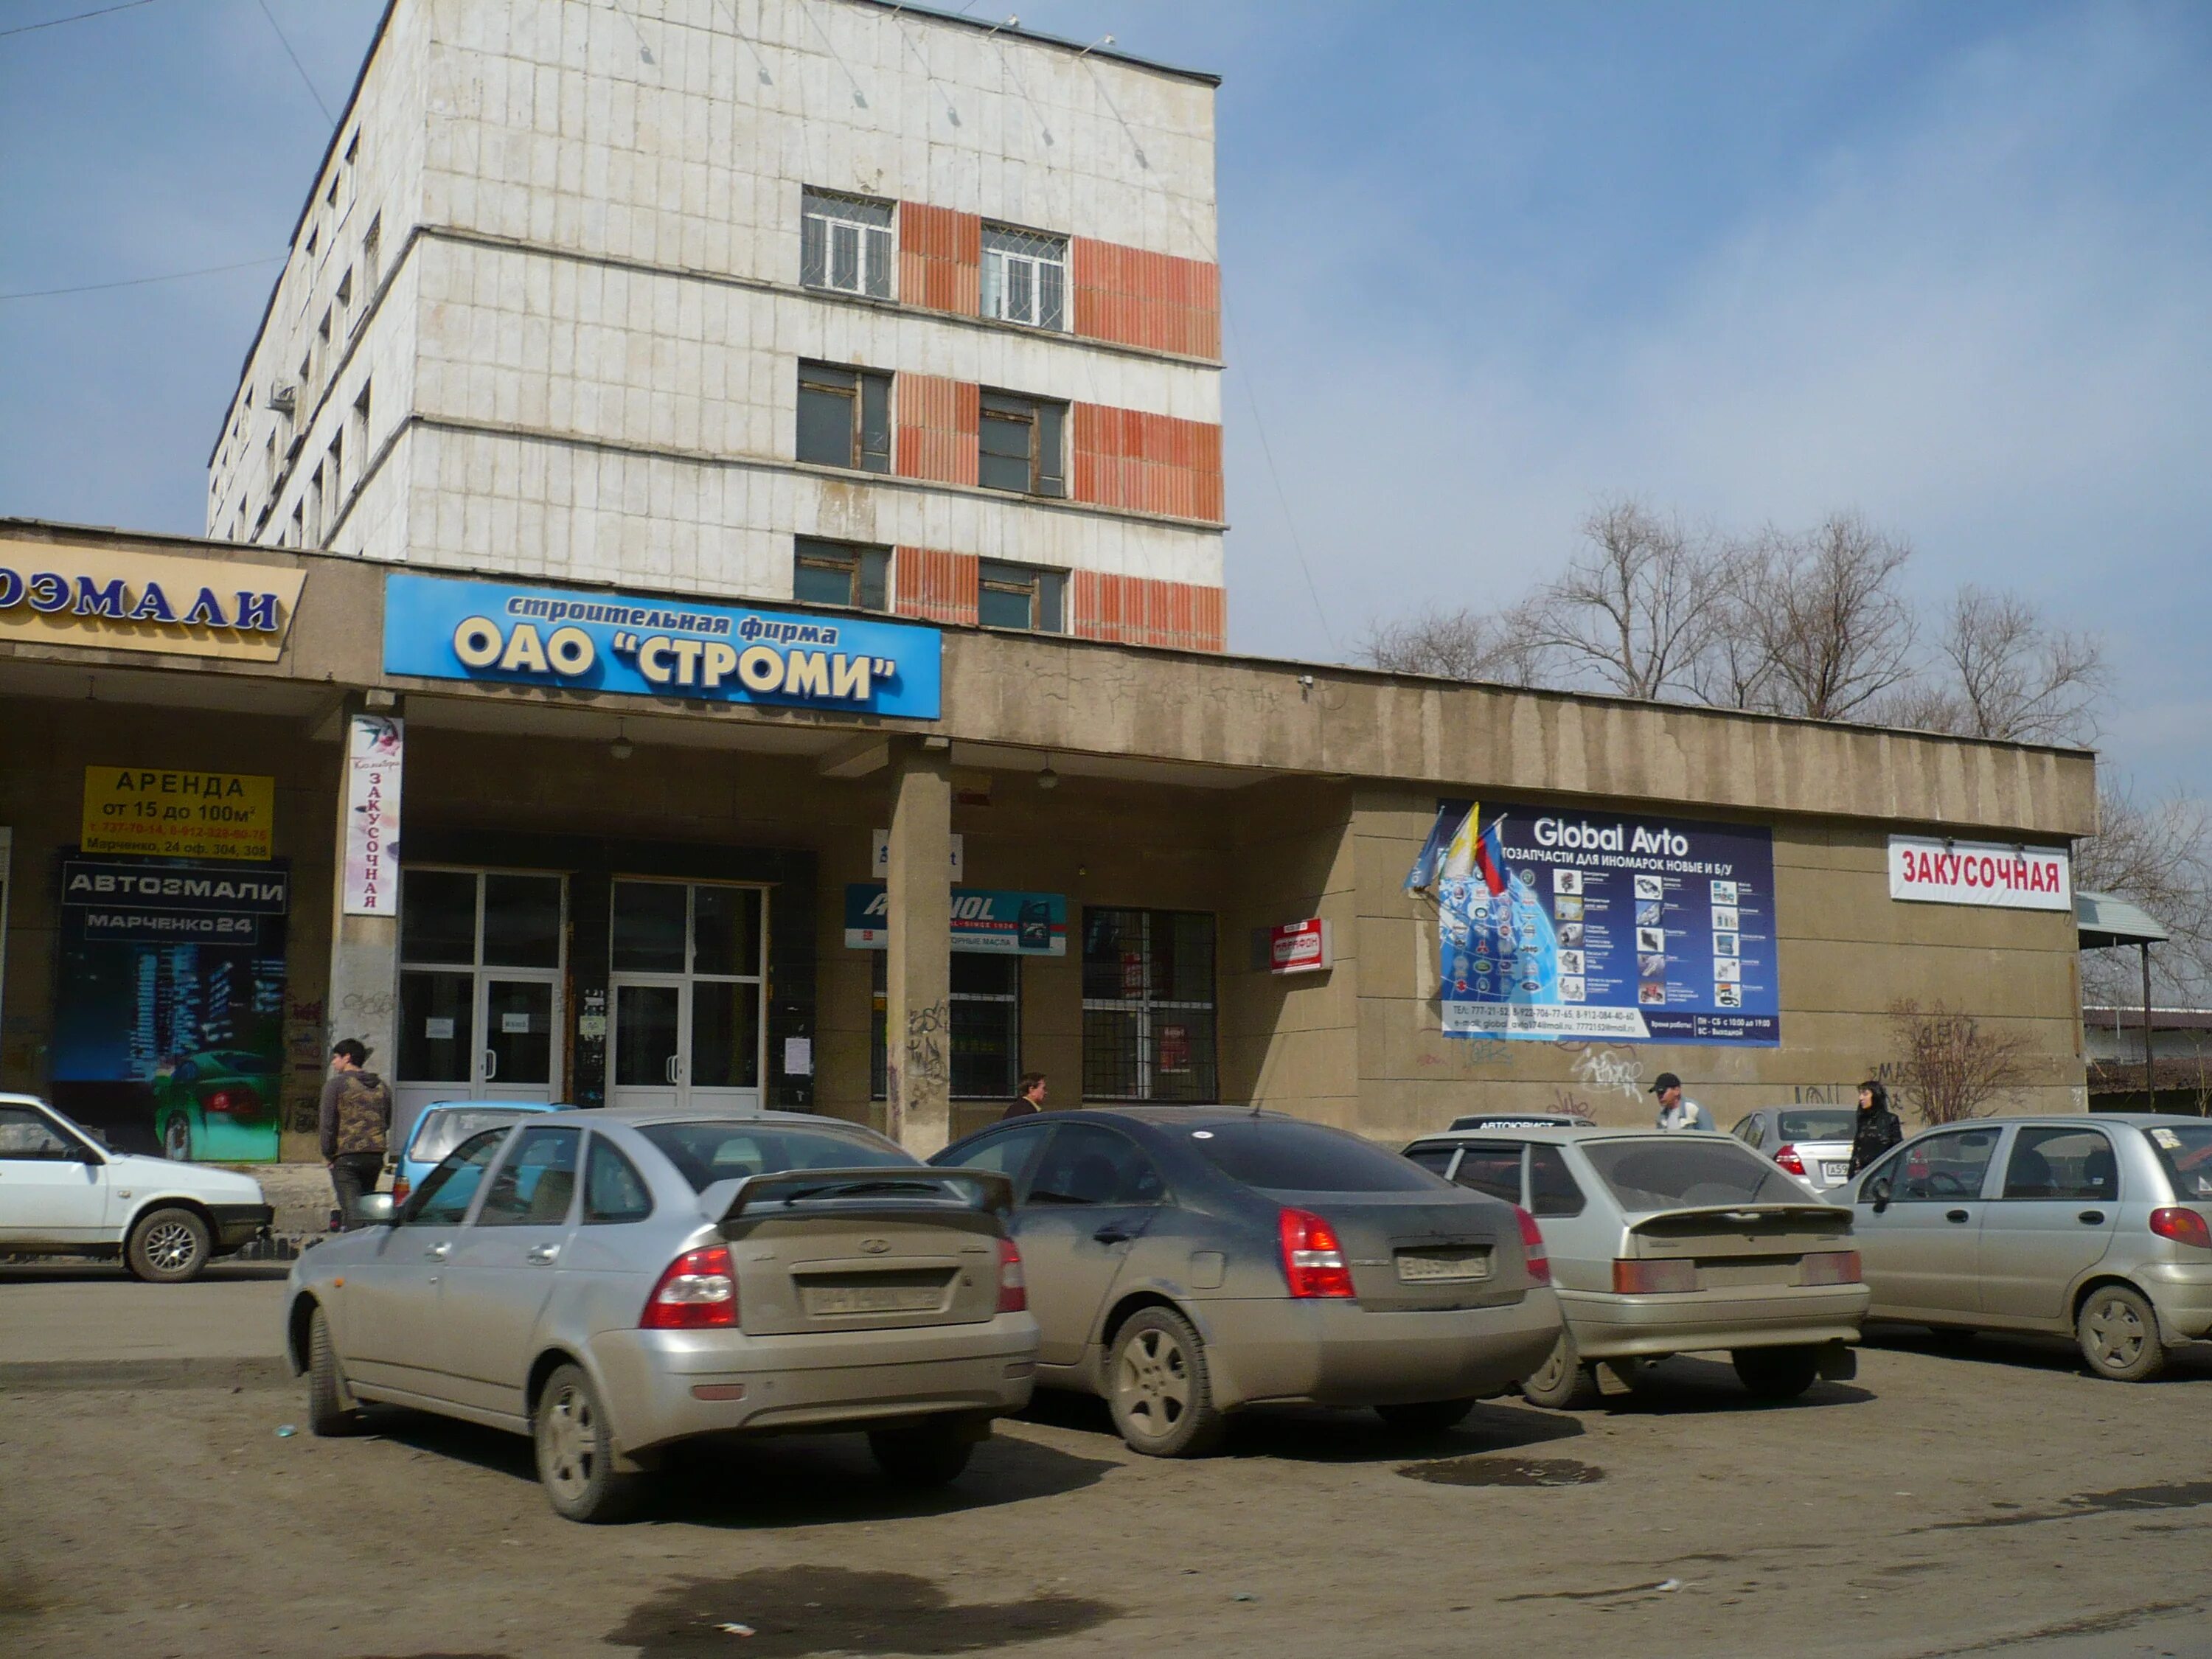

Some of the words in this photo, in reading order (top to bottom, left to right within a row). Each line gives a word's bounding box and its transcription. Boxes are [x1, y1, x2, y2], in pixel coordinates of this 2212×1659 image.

[506, 596, 730, 635] строительная
[738, 614, 839, 646] фирма
[453, 615, 594, 677] ОАО
[116, 771, 244, 799] АРЕНДА
[102, 803, 127, 816] от
[134, 801, 157, 818] 15
[163, 807, 190, 821] до
[164, 841, 180, 852] 24
[364, 773, 382, 908] ЗАКУСОЧНАЯ
[1534, 817, 1622, 851] Global
[1630, 825, 1689, 857] Avto
[1502, 848, 1573, 863] ТОЗАПЧАСТИ
[1576, 853, 1599, 866] ДЛЯ
[1601, 855, 1664, 871] ИНОМАРОК
[1666, 860, 1703, 874] НОВЫЕ
[1705, 863, 1712, 874] И
[1714, 863, 1733, 876] Б/У
[1902, 850, 2059, 893] ЗАКУСОЧНАЯ
[216, 917, 252, 933] 24
